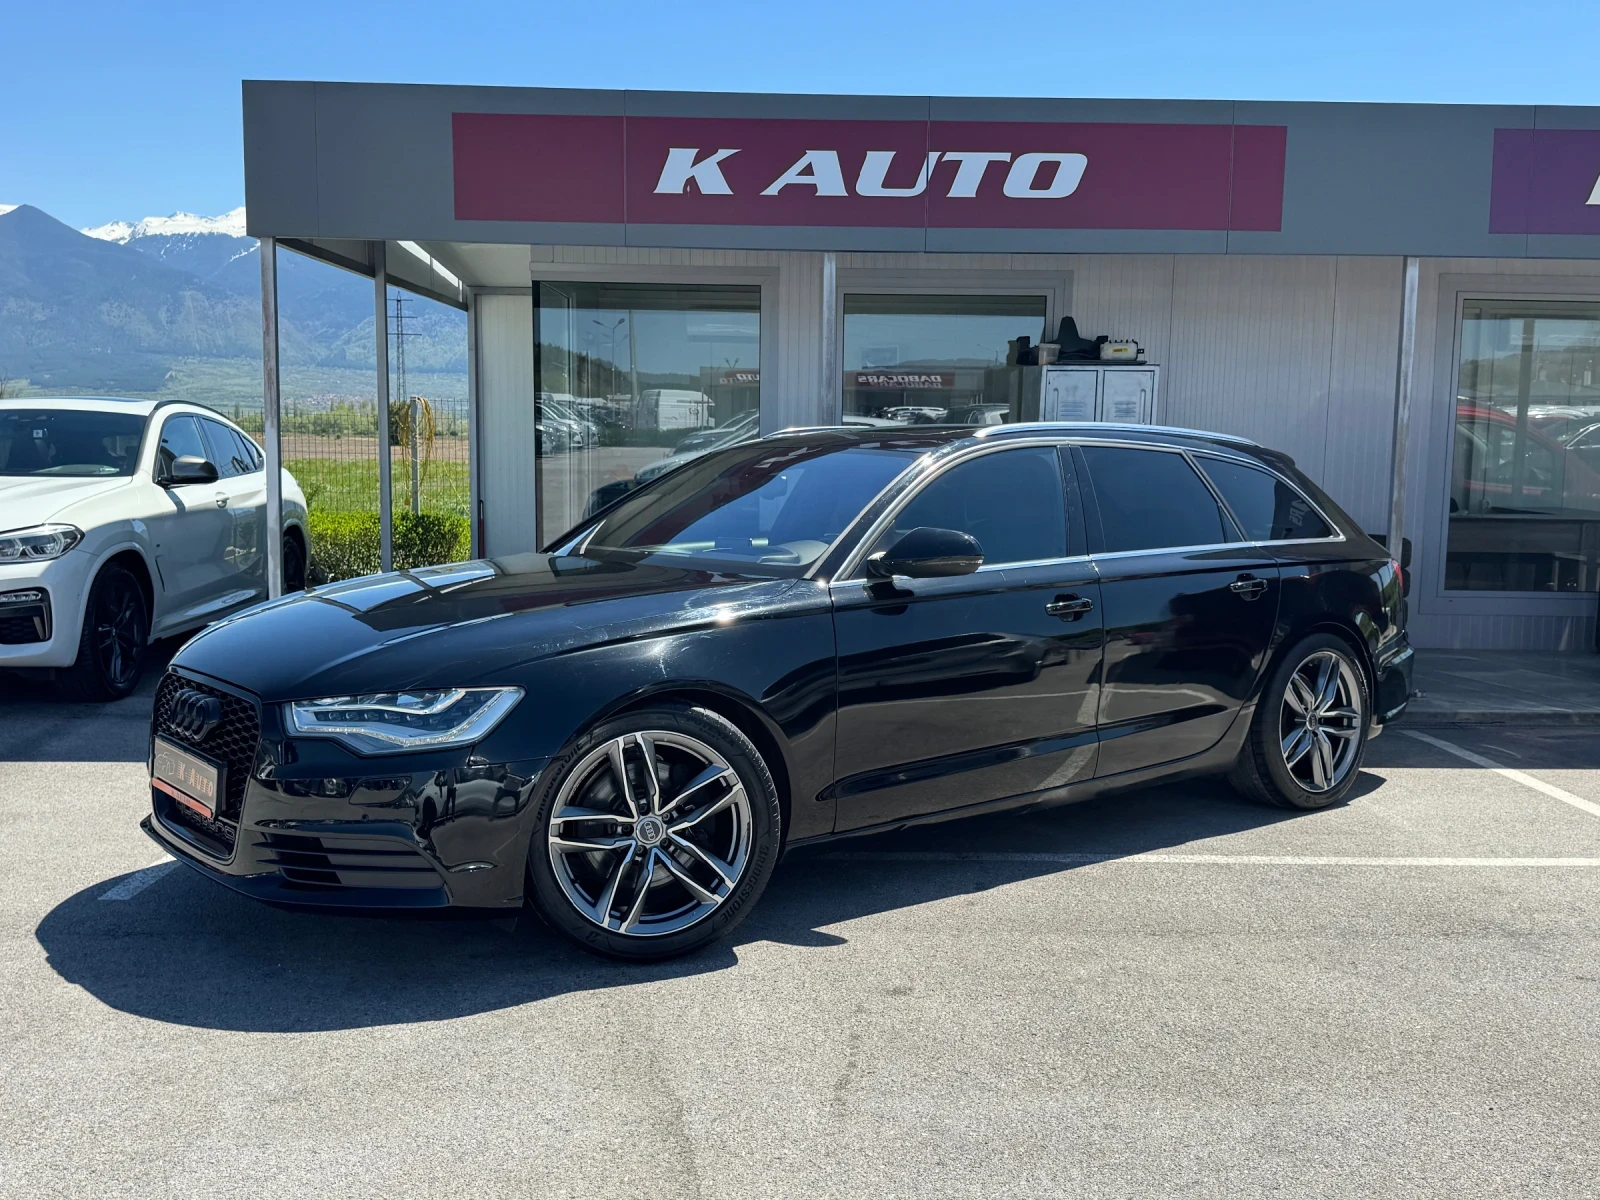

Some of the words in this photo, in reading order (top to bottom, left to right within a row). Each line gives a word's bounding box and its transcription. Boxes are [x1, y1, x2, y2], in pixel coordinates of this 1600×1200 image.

[653, 147, 743, 195] K
[759, 150, 1088, 199] AUTO
[188, 769, 213, 797] AUTO
[720, 844, 770, 924] BRIDGESTONE
